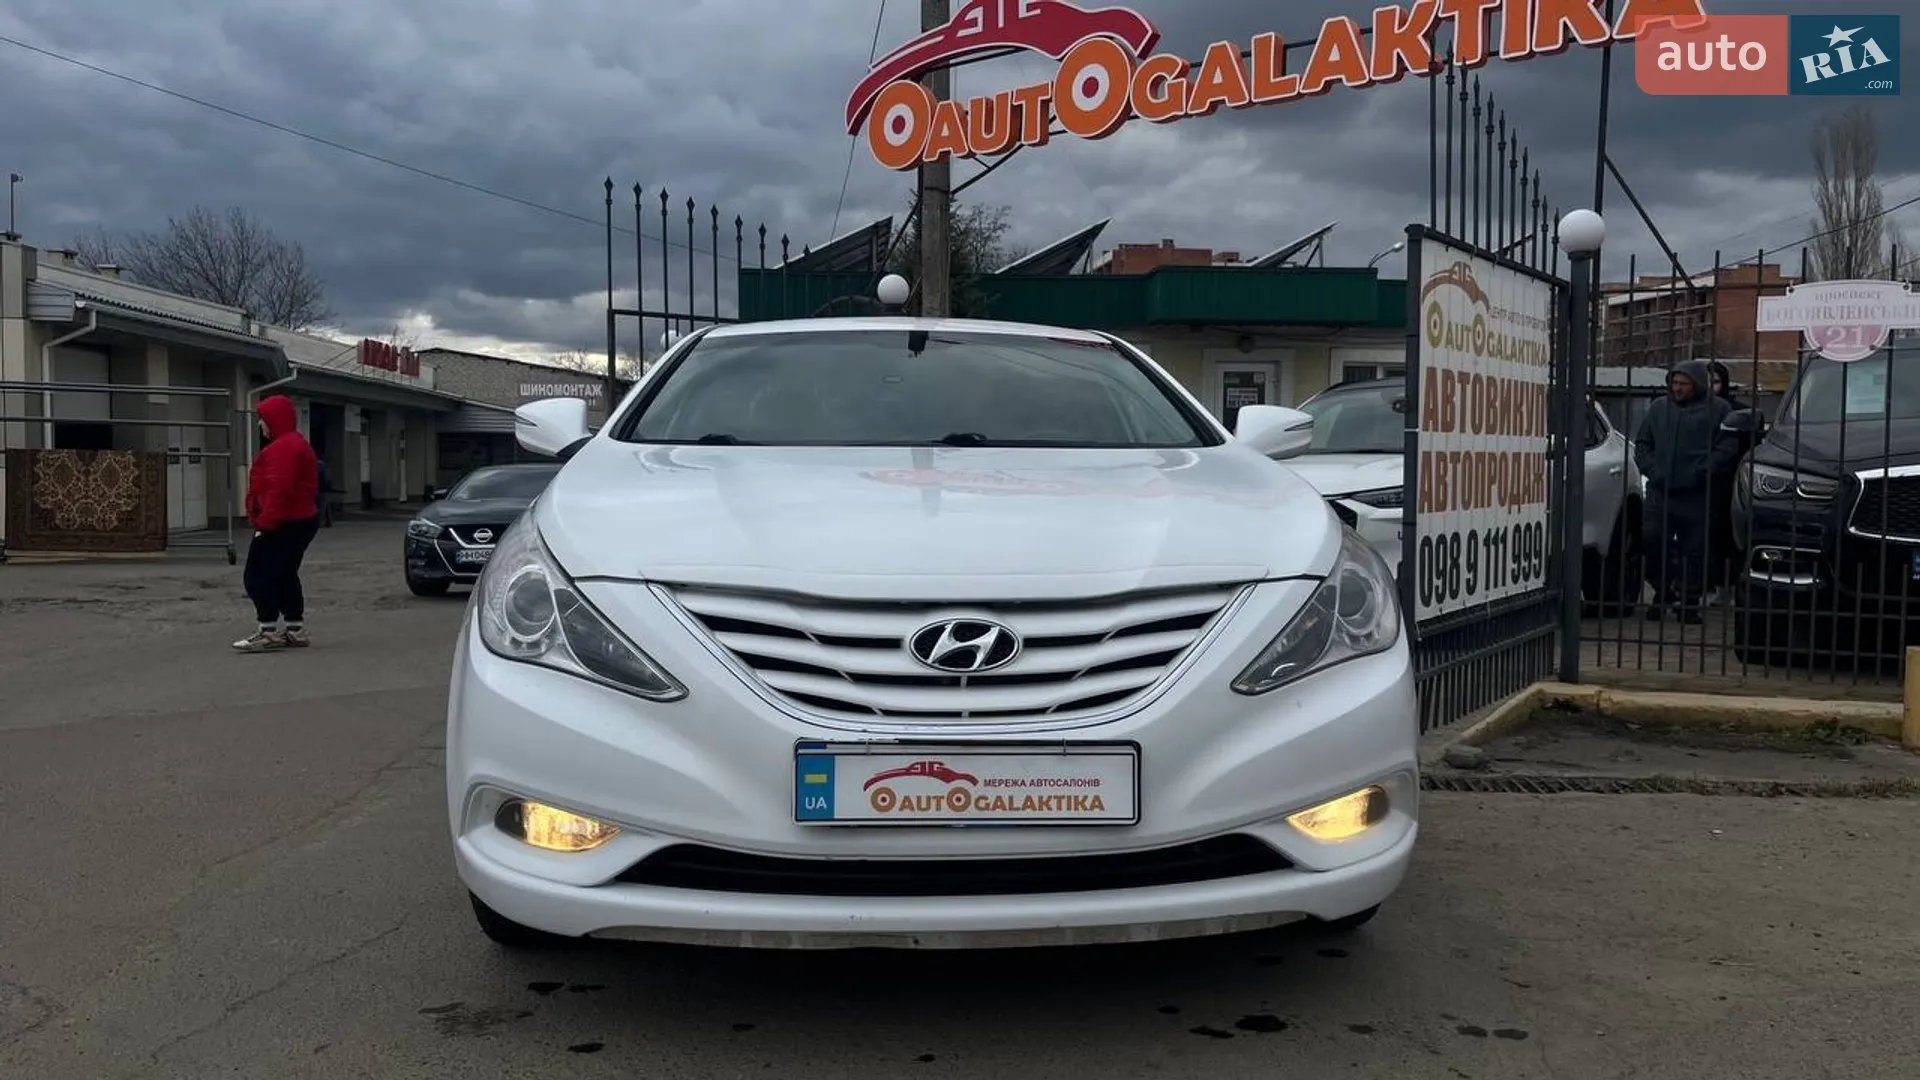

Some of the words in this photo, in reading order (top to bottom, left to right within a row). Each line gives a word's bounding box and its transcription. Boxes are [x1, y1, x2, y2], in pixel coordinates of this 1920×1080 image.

[1814, 289, 1883, 304] проспект
[1765, 303, 1920, 323] БОГОЯВЛЕНСЬКИ
[1826, 326, 1864, 348] 21
[519, 383, 603, 398] ШИНОМОНТАЖ
[1421, 366, 1546, 438] АВТОВИКУП
[1418, 451, 1546, 515] АВТОПРОДАЖ
[1419, 529, 1462, 608] 098
[1465, 528, 1480, 597] 9
[1483, 526, 1509, 592] 111
[1511, 520, 1543, 586] 999
[983, 778, 1027, 788] МЕРЕЖА
[1029, 777, 1101, 788] АВТОСАЛОНІВ
[804, 796, 828, 810] UA
